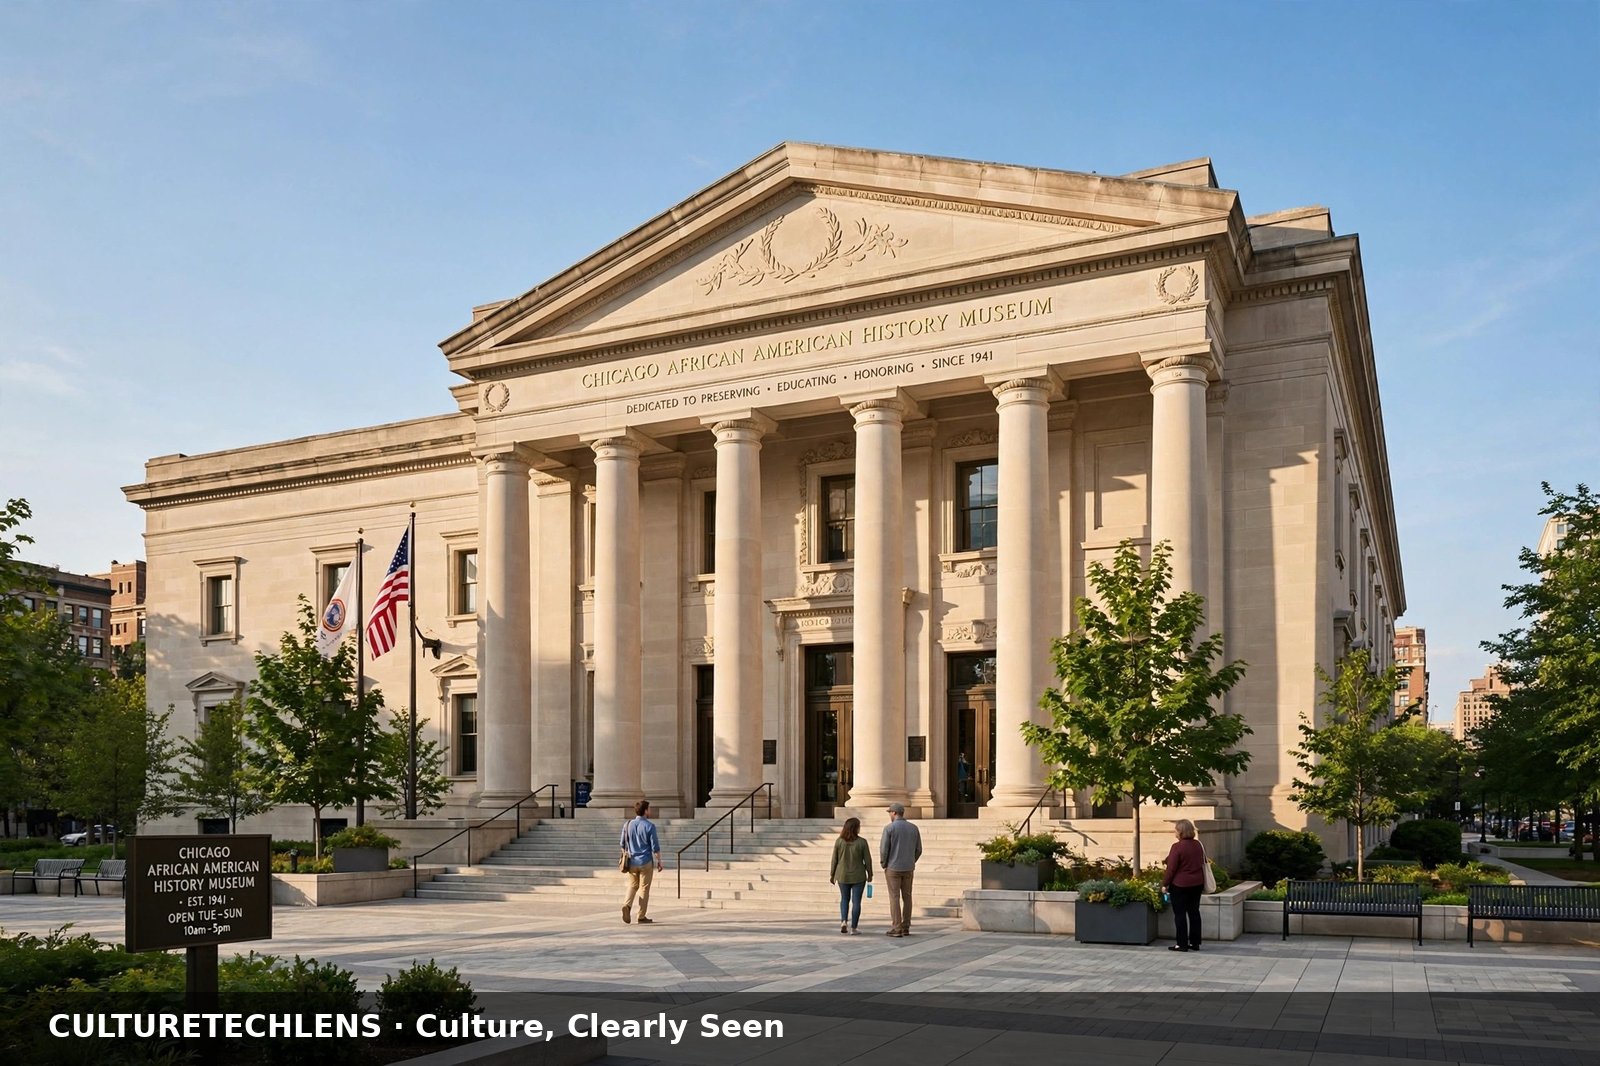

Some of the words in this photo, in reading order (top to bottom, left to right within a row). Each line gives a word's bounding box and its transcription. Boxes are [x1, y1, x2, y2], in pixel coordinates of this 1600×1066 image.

[582, 363, 660, 389] CHICAGO
[667, 348, 744, 376] AFRICAN
[753, 330, 853, 362] AMERICAN
[862, 314, 949, 344] HISTORY
[958, 297, 1053, 328] MUSEUM
[626, 398, 679, 415] DEDICATED
[683, 395, 697, 407] TO
[701, 385, 761, 404] PRESERVING
[777, 374, 837, 392] EDUCATING
[854, 362, 914, 381] HONORING
[932, 354, 965, 369] SINCE
[970, 350, 993, 363] 1941
[178, 846, 231, 860] CHICAGO
[147, 862, 199, 877] AFRICAN
[203, 860, 260, 874] AMERICAN
[154, 878, 205, 893] HISTORY
[208, 876, 255, 890] MUSEUM
[187, 896, 205, 907] EST.
[208, 894, 226, 906] 1941
[168, 911, 195, 924] OPEN
